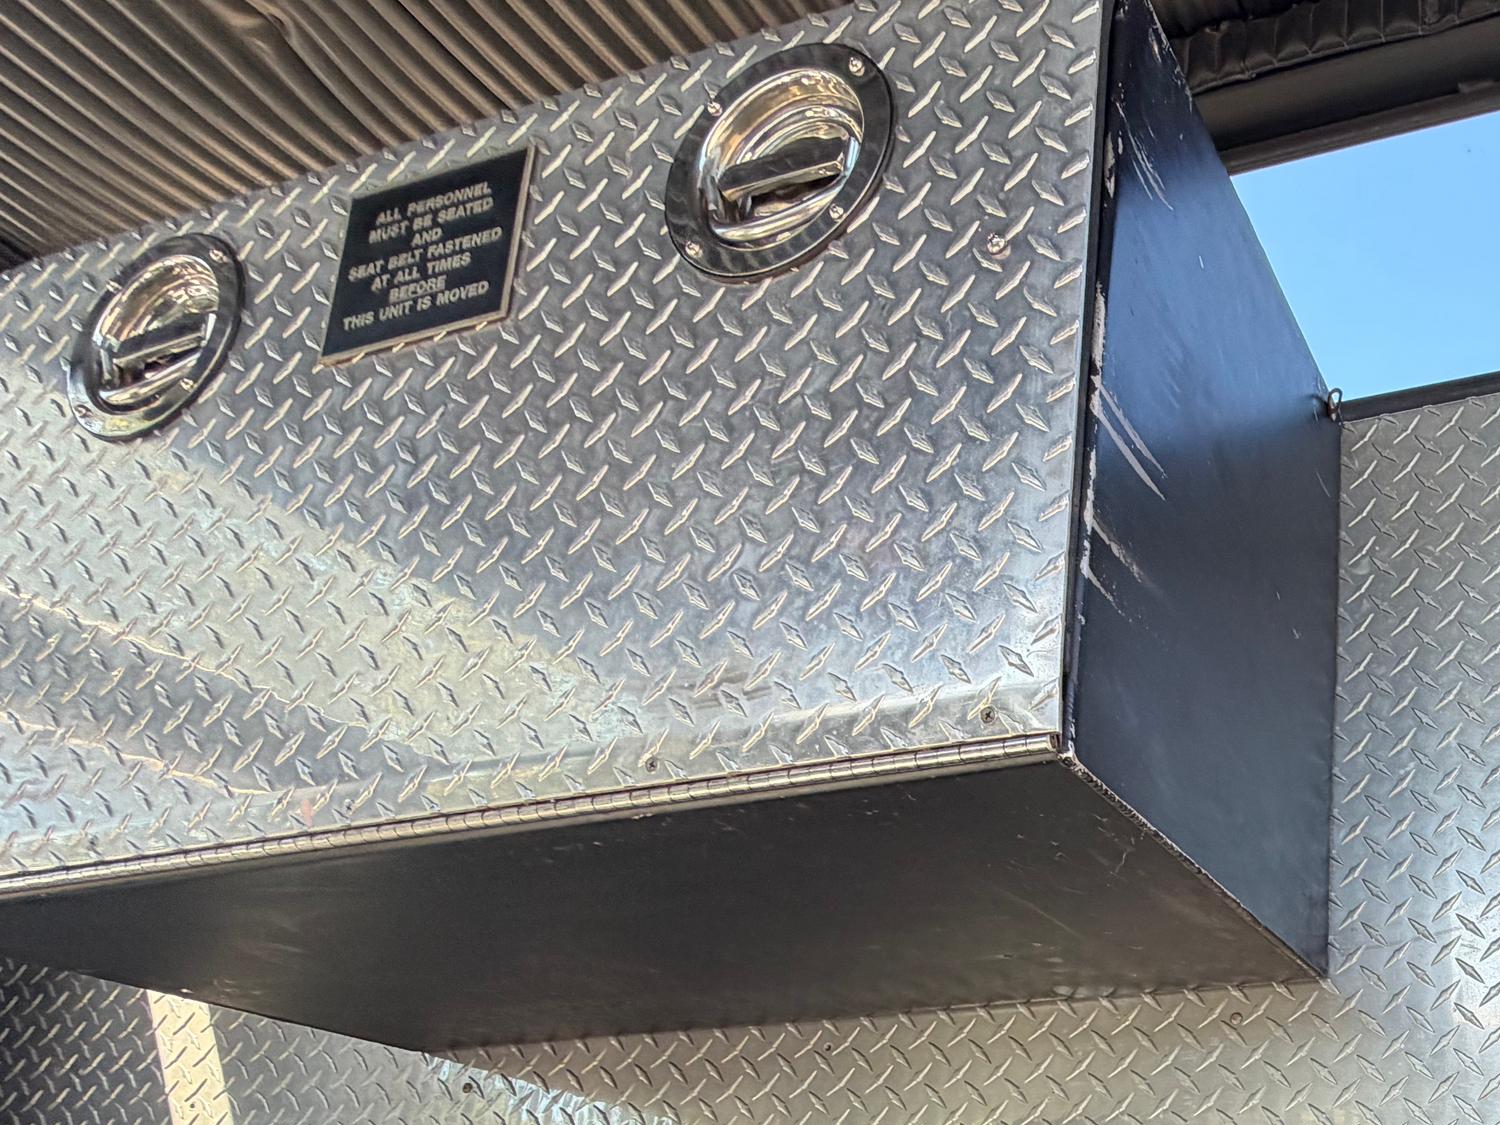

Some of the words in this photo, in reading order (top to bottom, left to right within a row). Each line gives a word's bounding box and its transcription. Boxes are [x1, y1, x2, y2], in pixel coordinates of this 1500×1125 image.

[368, 220, 410, 244] MUST
[412, 213, 433, 231] BE
[437, 197, 494, 224] SEATED
[376, 207, 402, 226] ALL
[407, 181, 492, 217] PERSONNEL
[348, 259, 385, 282] SEAT
[388, 248, 424, 270] BELT
[427, 226, 503, 259] FASTENED
[411, 227, 443, 247] AND
[371, 273, 391, 294] AT
[394, 266, 421, 285] ALL
[426, 252, 472, 275] TIMES
[389, 275, 448, 303] BEFORE
[343, 311, 375, 331] THIS
[379, 300, 414, 321] UNIT
[416, 296, 432, 311] IS
[436, 280, 490, 306] MOVED
